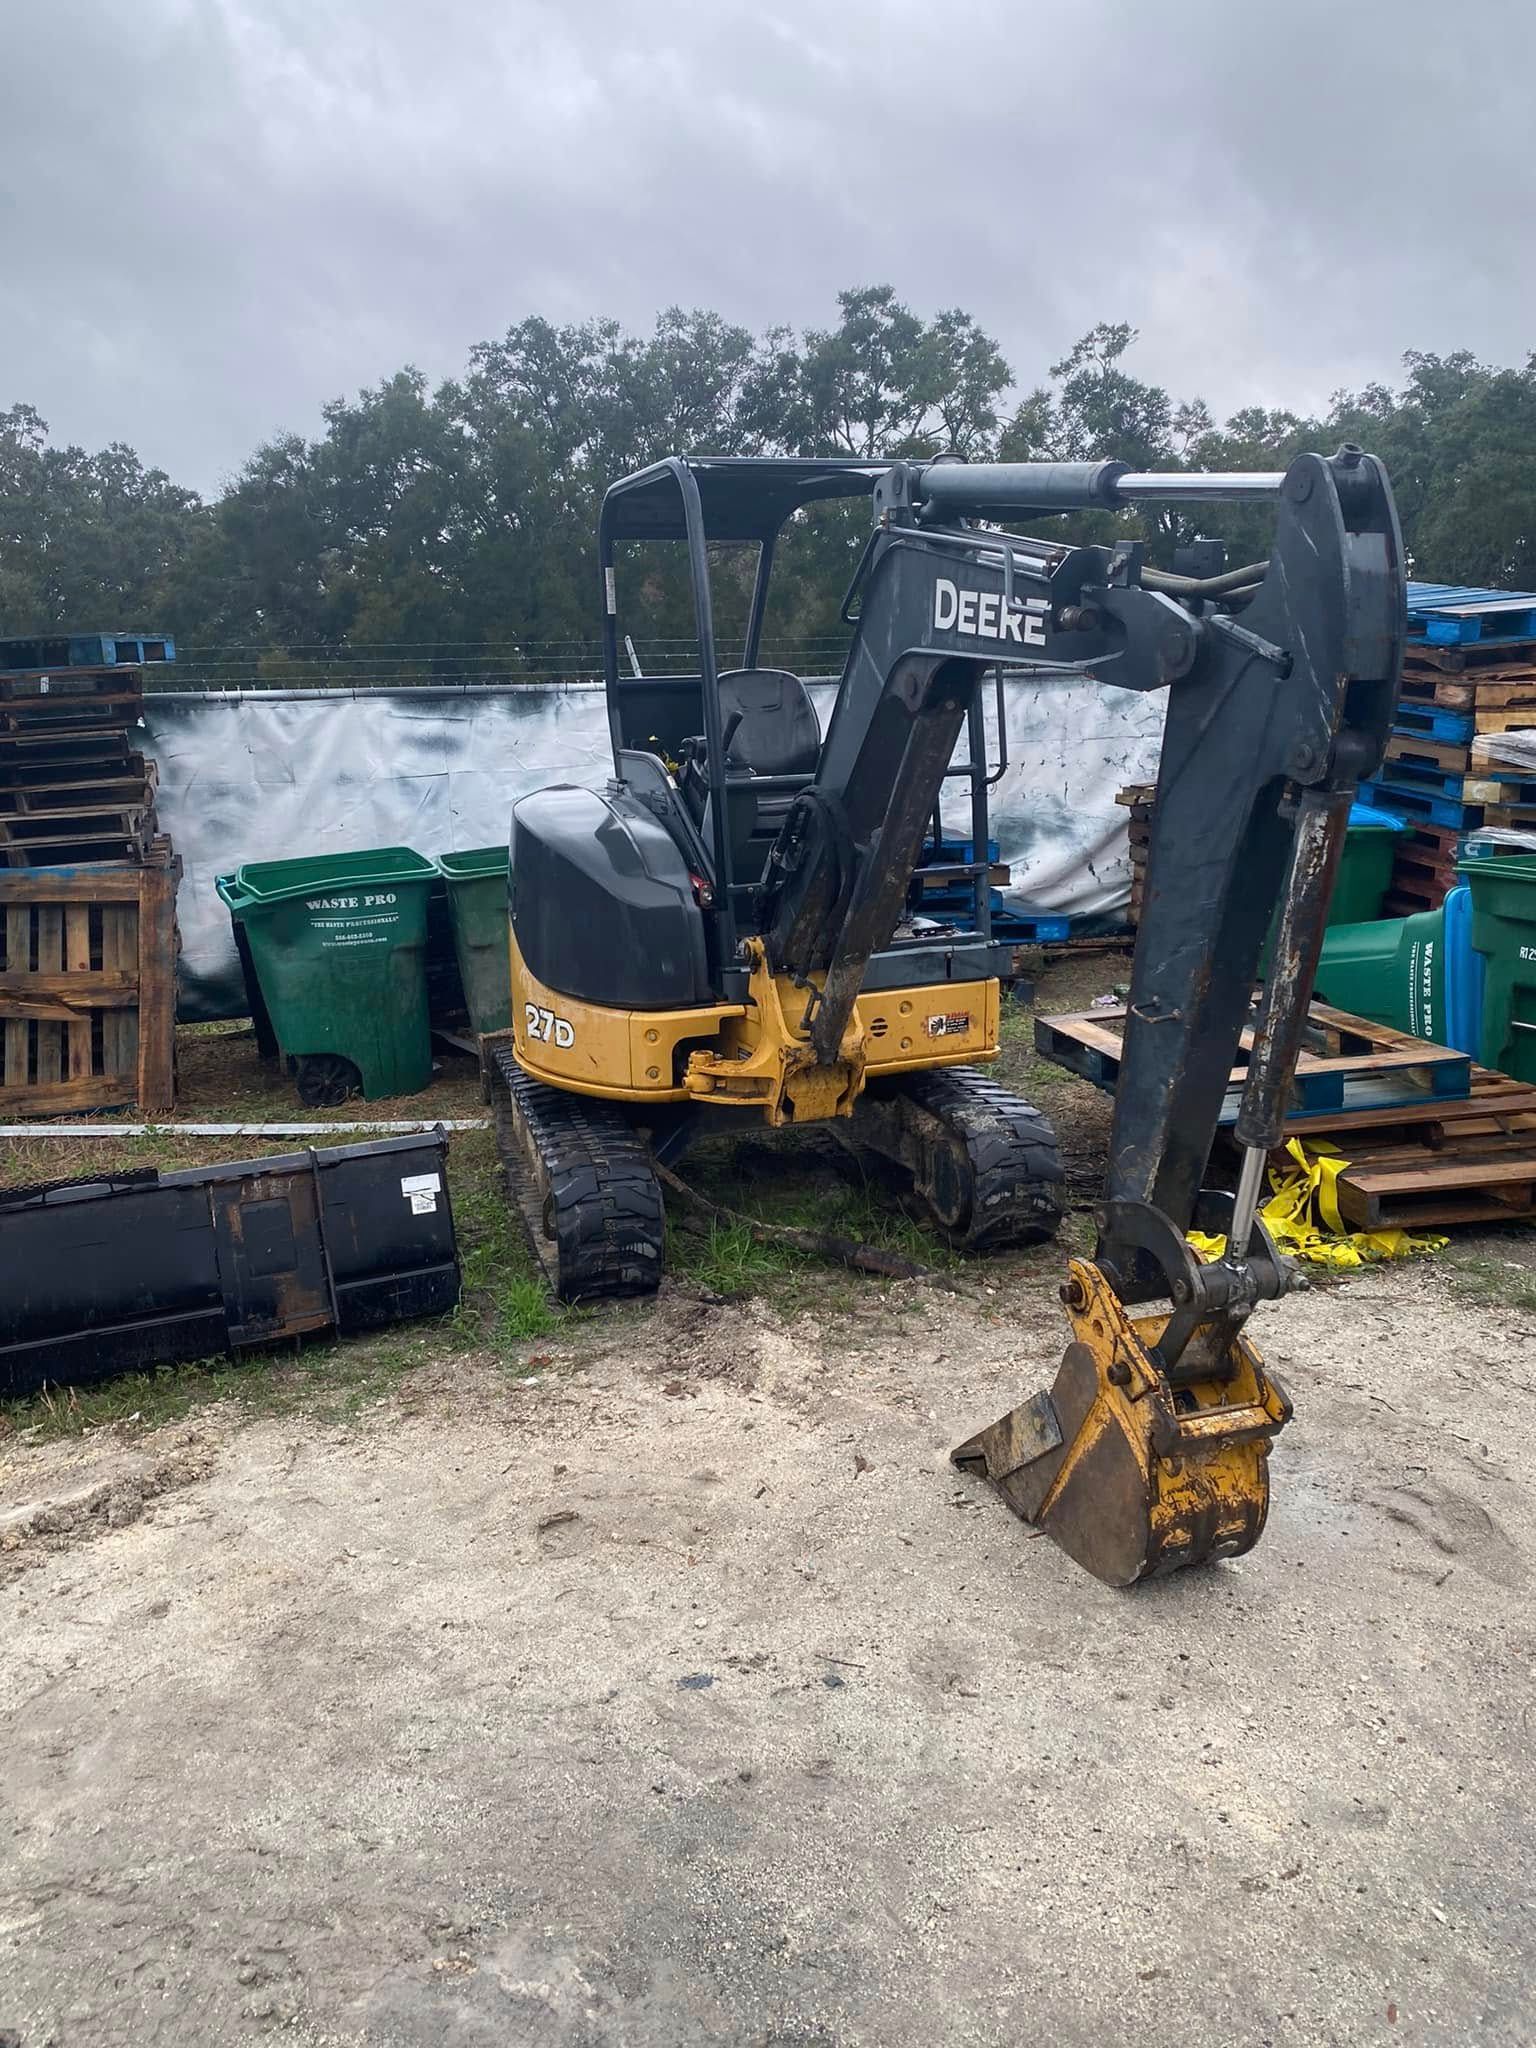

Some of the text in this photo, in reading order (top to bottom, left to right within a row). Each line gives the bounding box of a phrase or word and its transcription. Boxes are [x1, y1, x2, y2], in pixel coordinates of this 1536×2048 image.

[934, 578, 1048, 646] DEERE
[305, 893, 397, 910] WASTE PRO
[1423, 941, 1434, 1037] WASTE PRO
[525, 1003, 575, 1049] 27D
